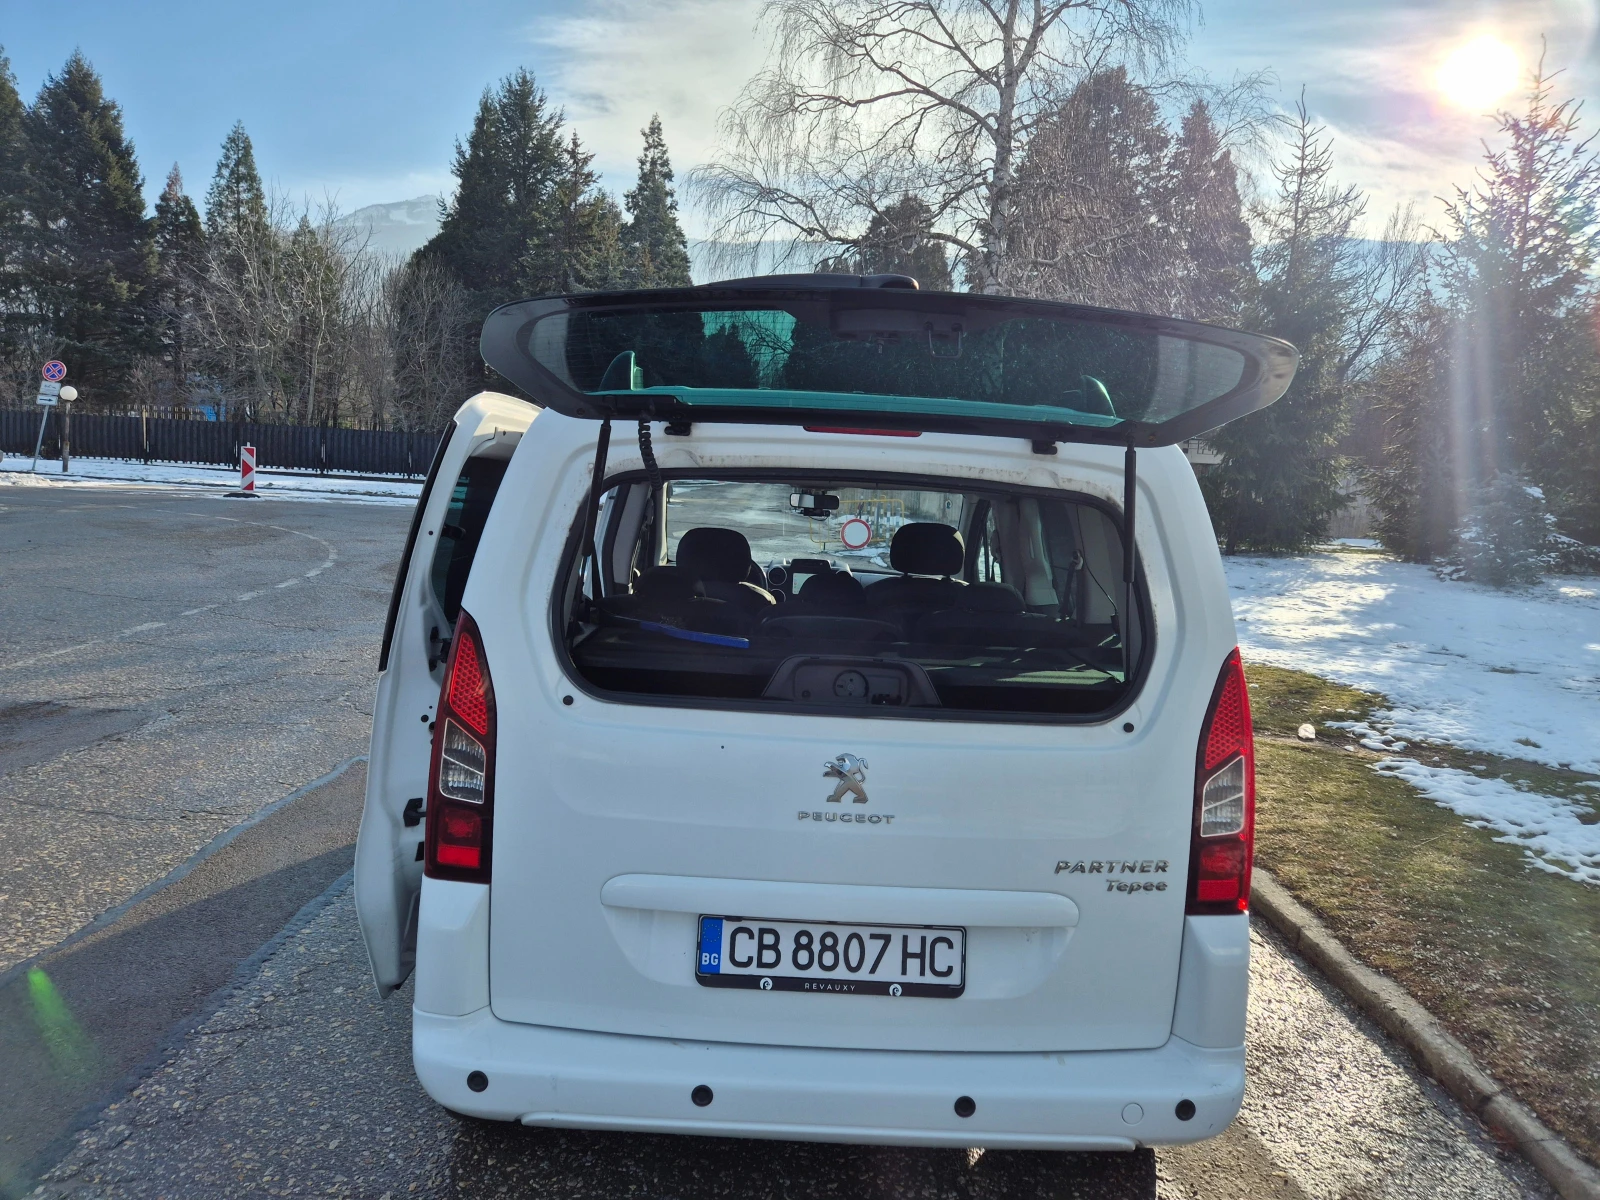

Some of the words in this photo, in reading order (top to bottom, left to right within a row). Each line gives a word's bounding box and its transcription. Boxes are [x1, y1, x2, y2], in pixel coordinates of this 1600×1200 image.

[798, 811, 895, 824] PEUGEOT
[1054, 860, 1168, 874] PARTNER
[1106, 879, 1167, 894] Tepee
[701, 952, 719, 965] BG
[729, 926, 782, 969] CB
[791, 929, 892, 975] 8807
[901, 934, 954, 978] HC
[804, 982, 857, 992] REVAUXY
